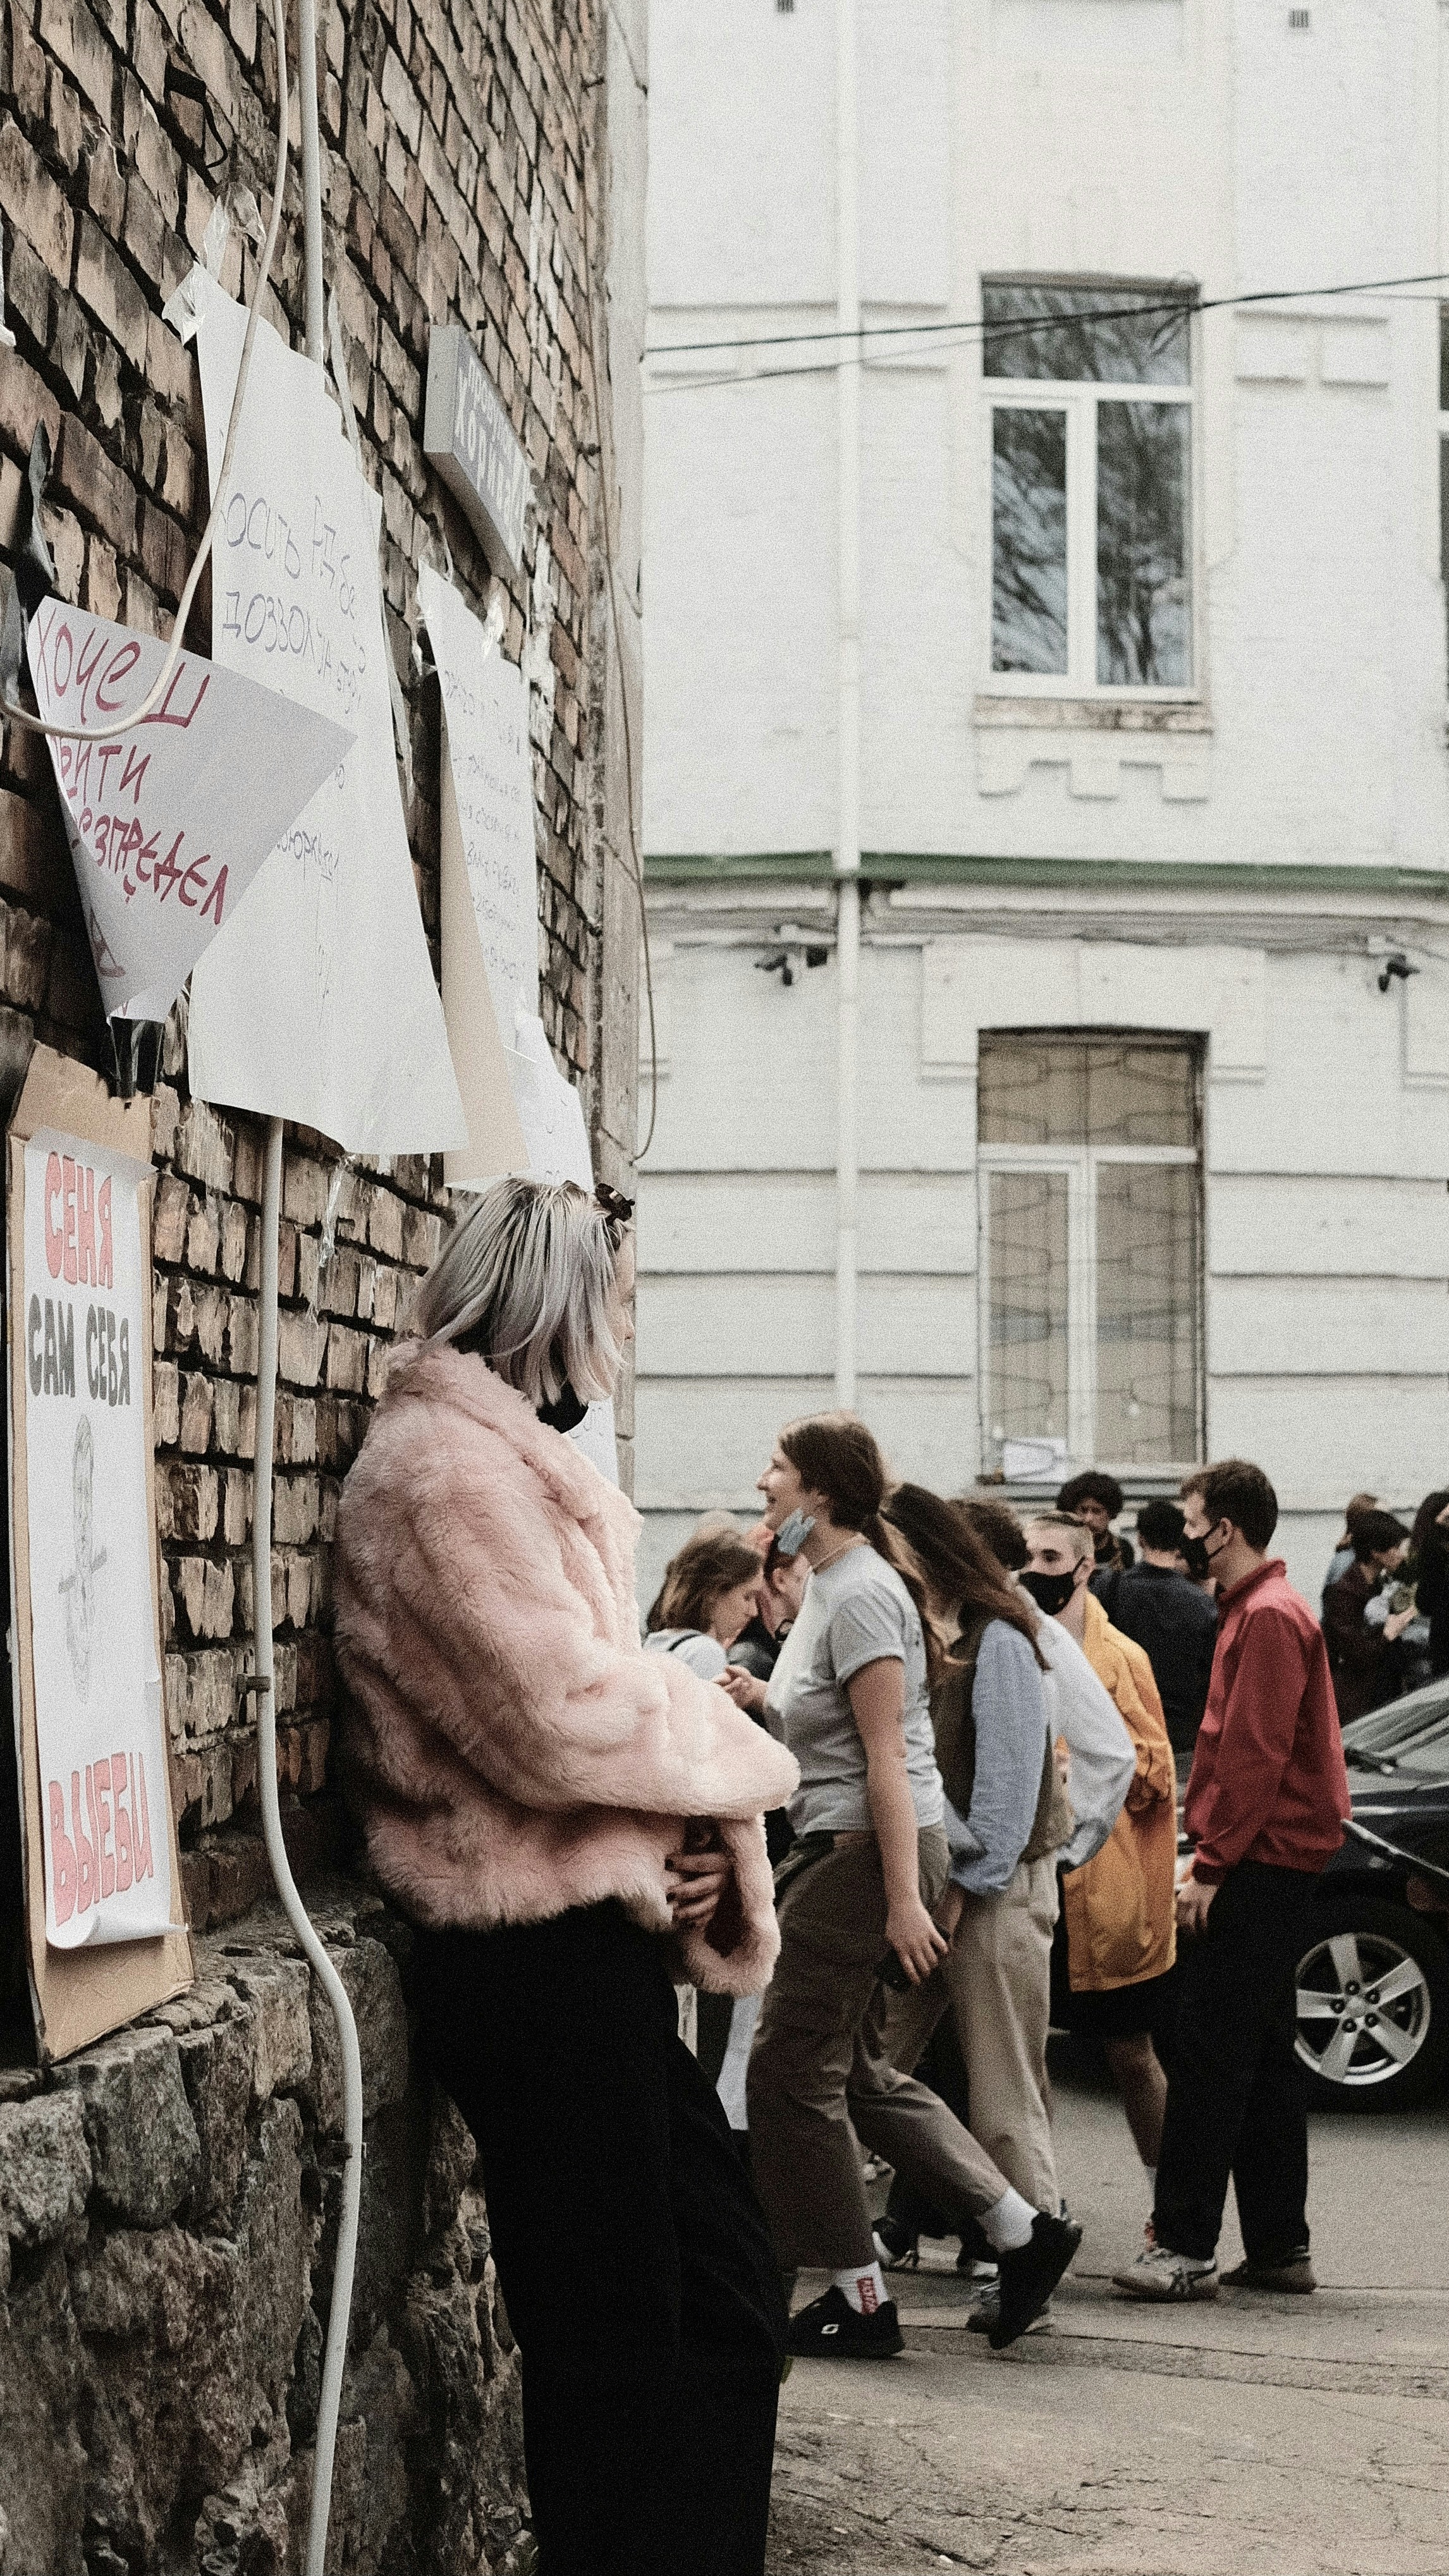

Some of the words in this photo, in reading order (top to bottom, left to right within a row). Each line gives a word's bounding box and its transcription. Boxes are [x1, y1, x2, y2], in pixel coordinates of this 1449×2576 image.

[217, 491, 301, 580] ОСИТЬ
[44, 1151, 113, 1289] СЕНЯ
[27, 1292, 76, 1399] САМ
[85, 1303, 131, 1408] СЕБЯ
[49, 1752, 154, 1926] ВЫЕБИ
